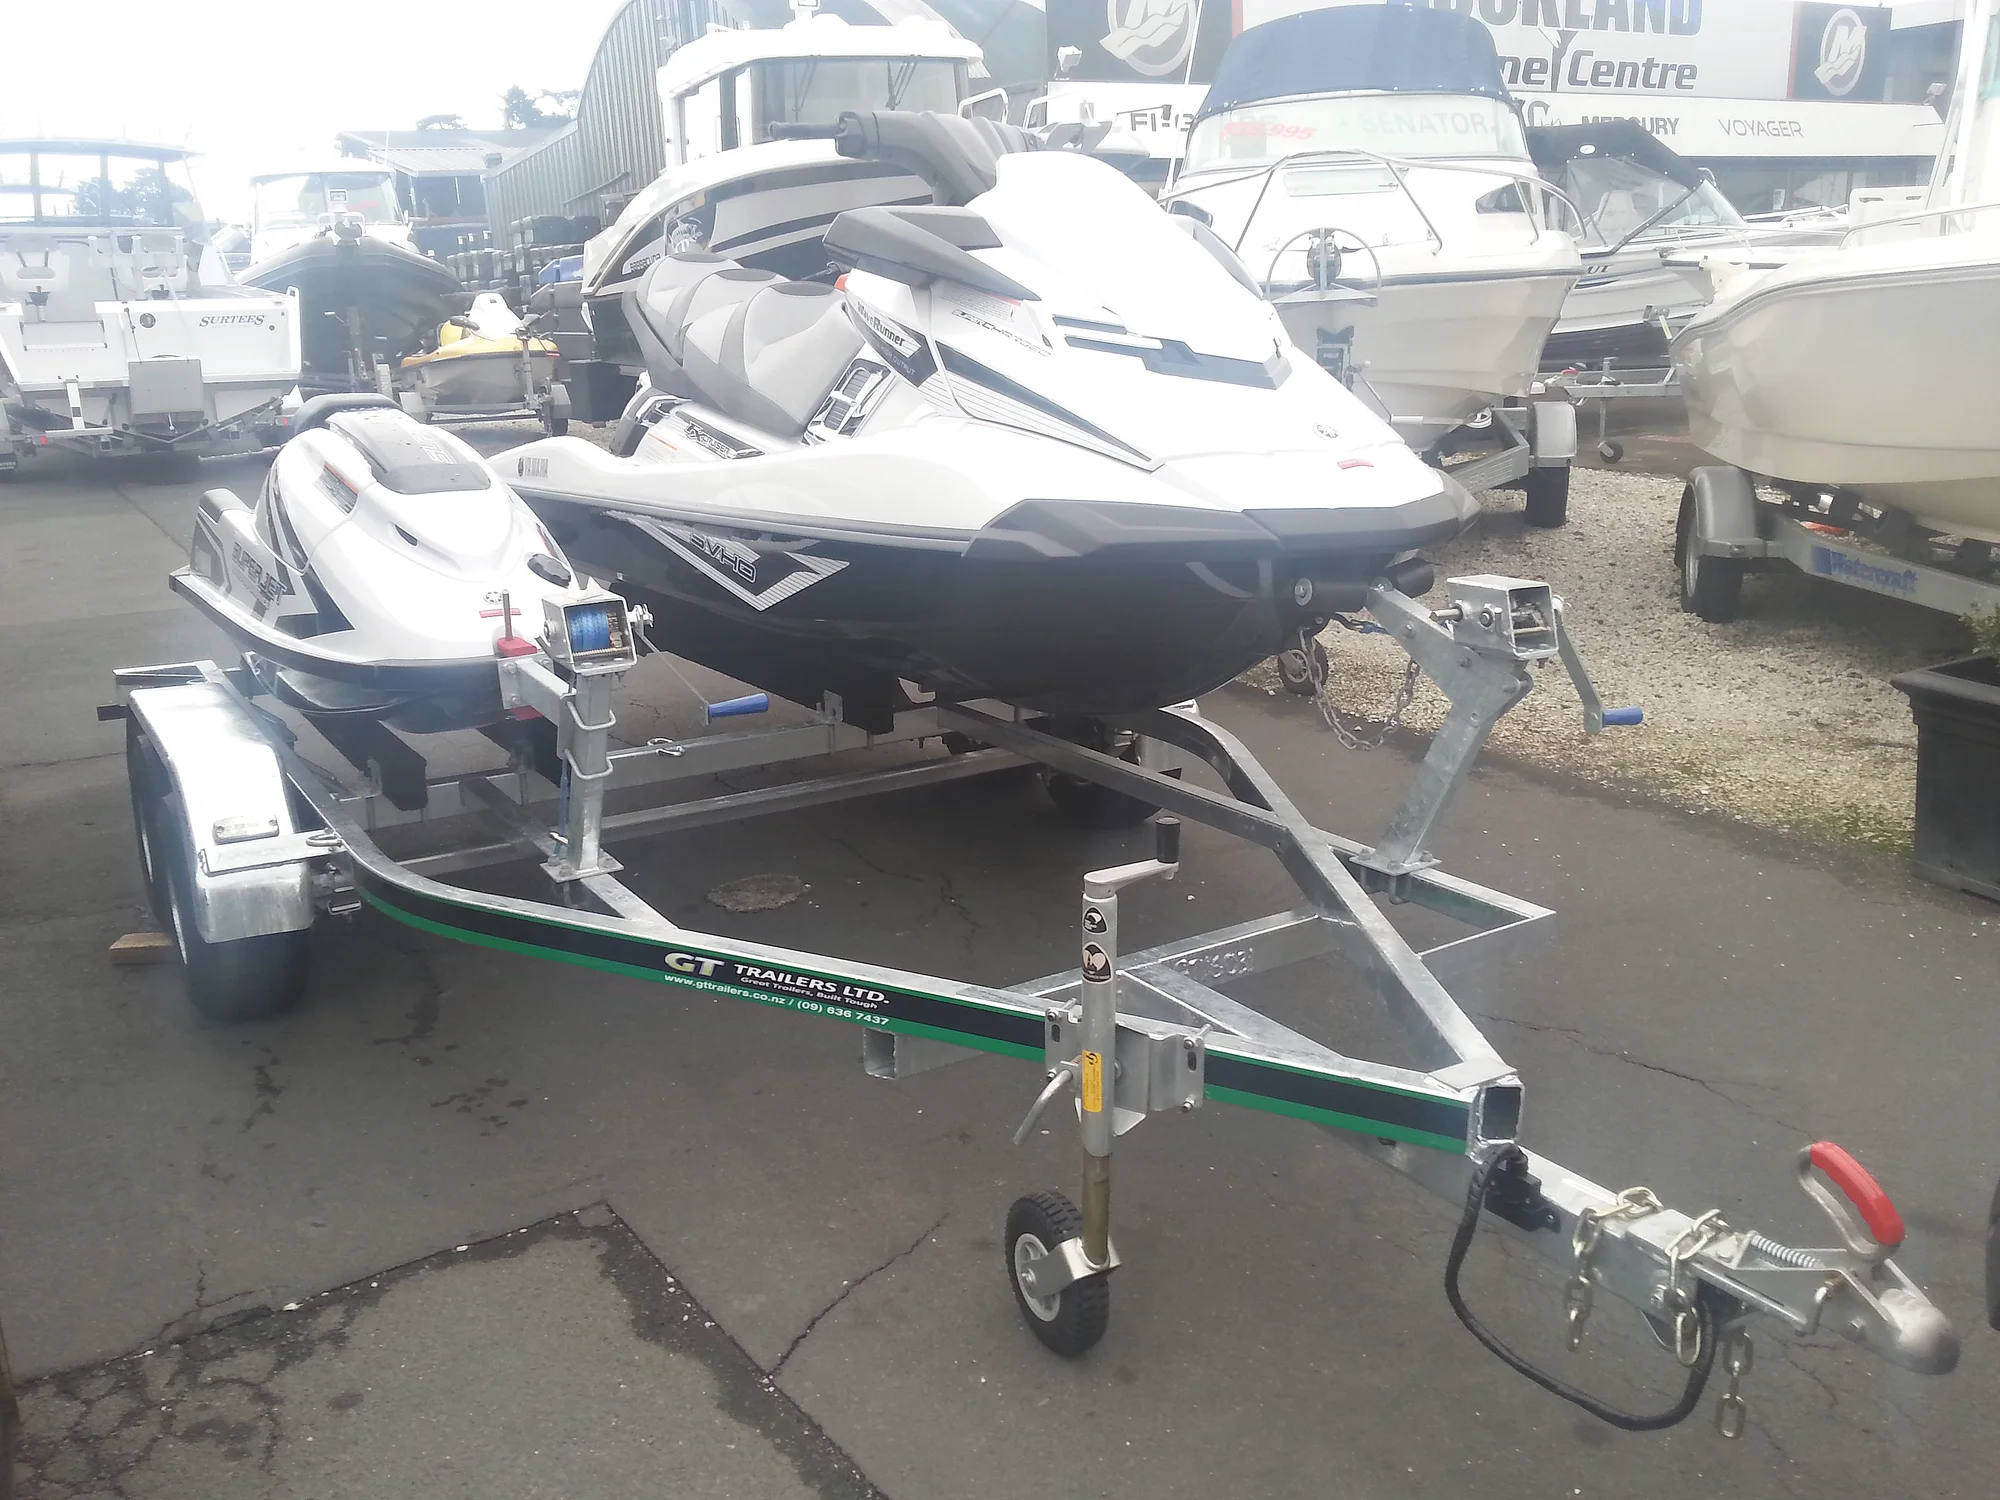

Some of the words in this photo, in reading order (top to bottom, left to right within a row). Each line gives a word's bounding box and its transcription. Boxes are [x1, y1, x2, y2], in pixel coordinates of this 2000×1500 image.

[1567, 50, 1698, 89] Centre
[1718, 119, 1803, 137] VOYAGER
[199, 314, 265, 327] SURTEES
[857, 301, 906, 346] WaveRunner
[664, 952, 725, 977] GT
[734, 964, 838, 993] TRAILERS
[843, 986, 890, 1005] LTD.
[740, 977, 770, 988] Great
[816, 991, 842, 1002] Built
[844, 997, 878, 1010] Tough
[664, 974, 786, 1005] www.gttrailers.co.nz
[797, 1001, 823, 1013] (09)
[826, 1006, 852, 1018] 636
[855, 1012, 890, 1026] 7437
